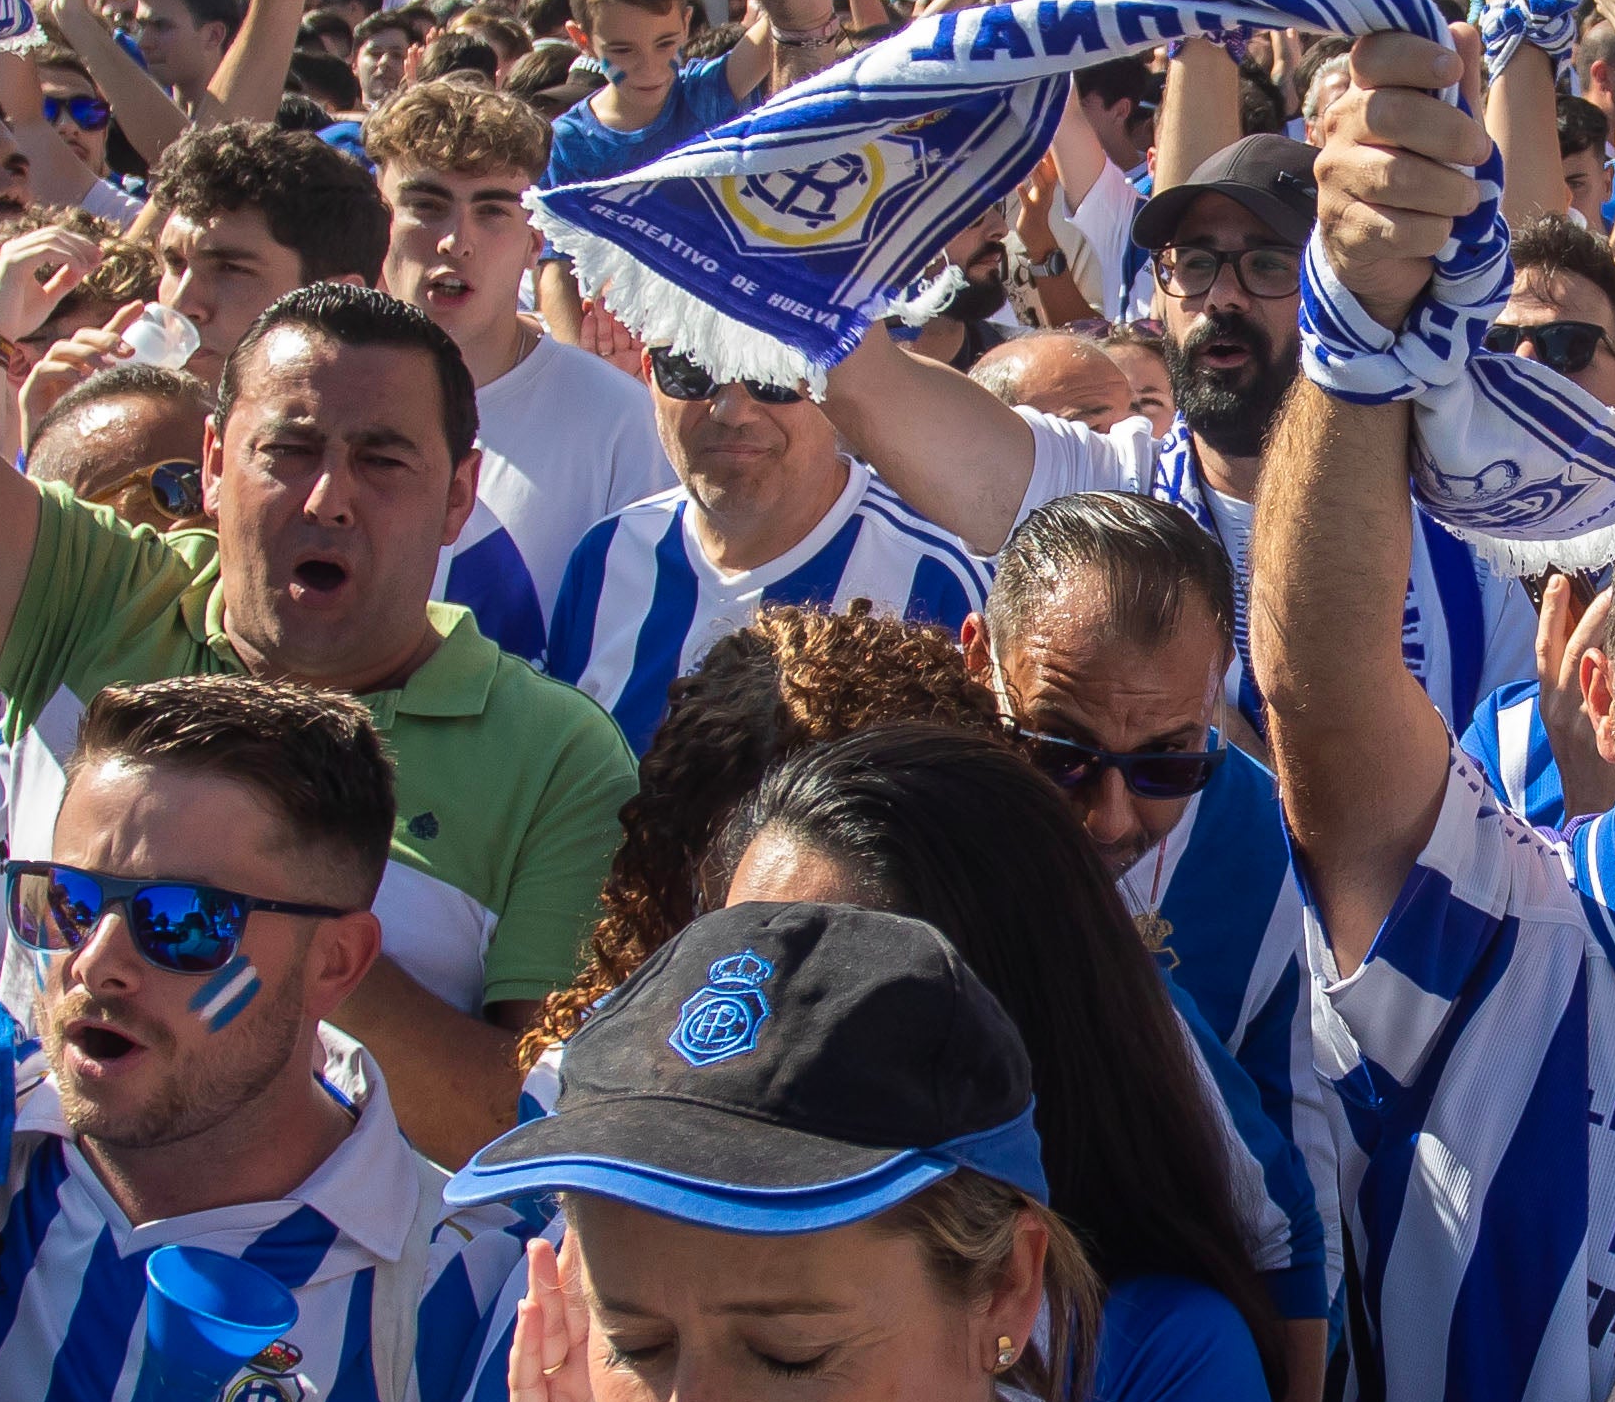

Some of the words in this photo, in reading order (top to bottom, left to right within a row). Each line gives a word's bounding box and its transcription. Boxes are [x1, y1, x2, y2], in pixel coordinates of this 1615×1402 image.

[589, 203, 721, 273] RECREATIVO
[730, 273, 761, 297] DE
[766, 293, 841, 331] HUELVA
